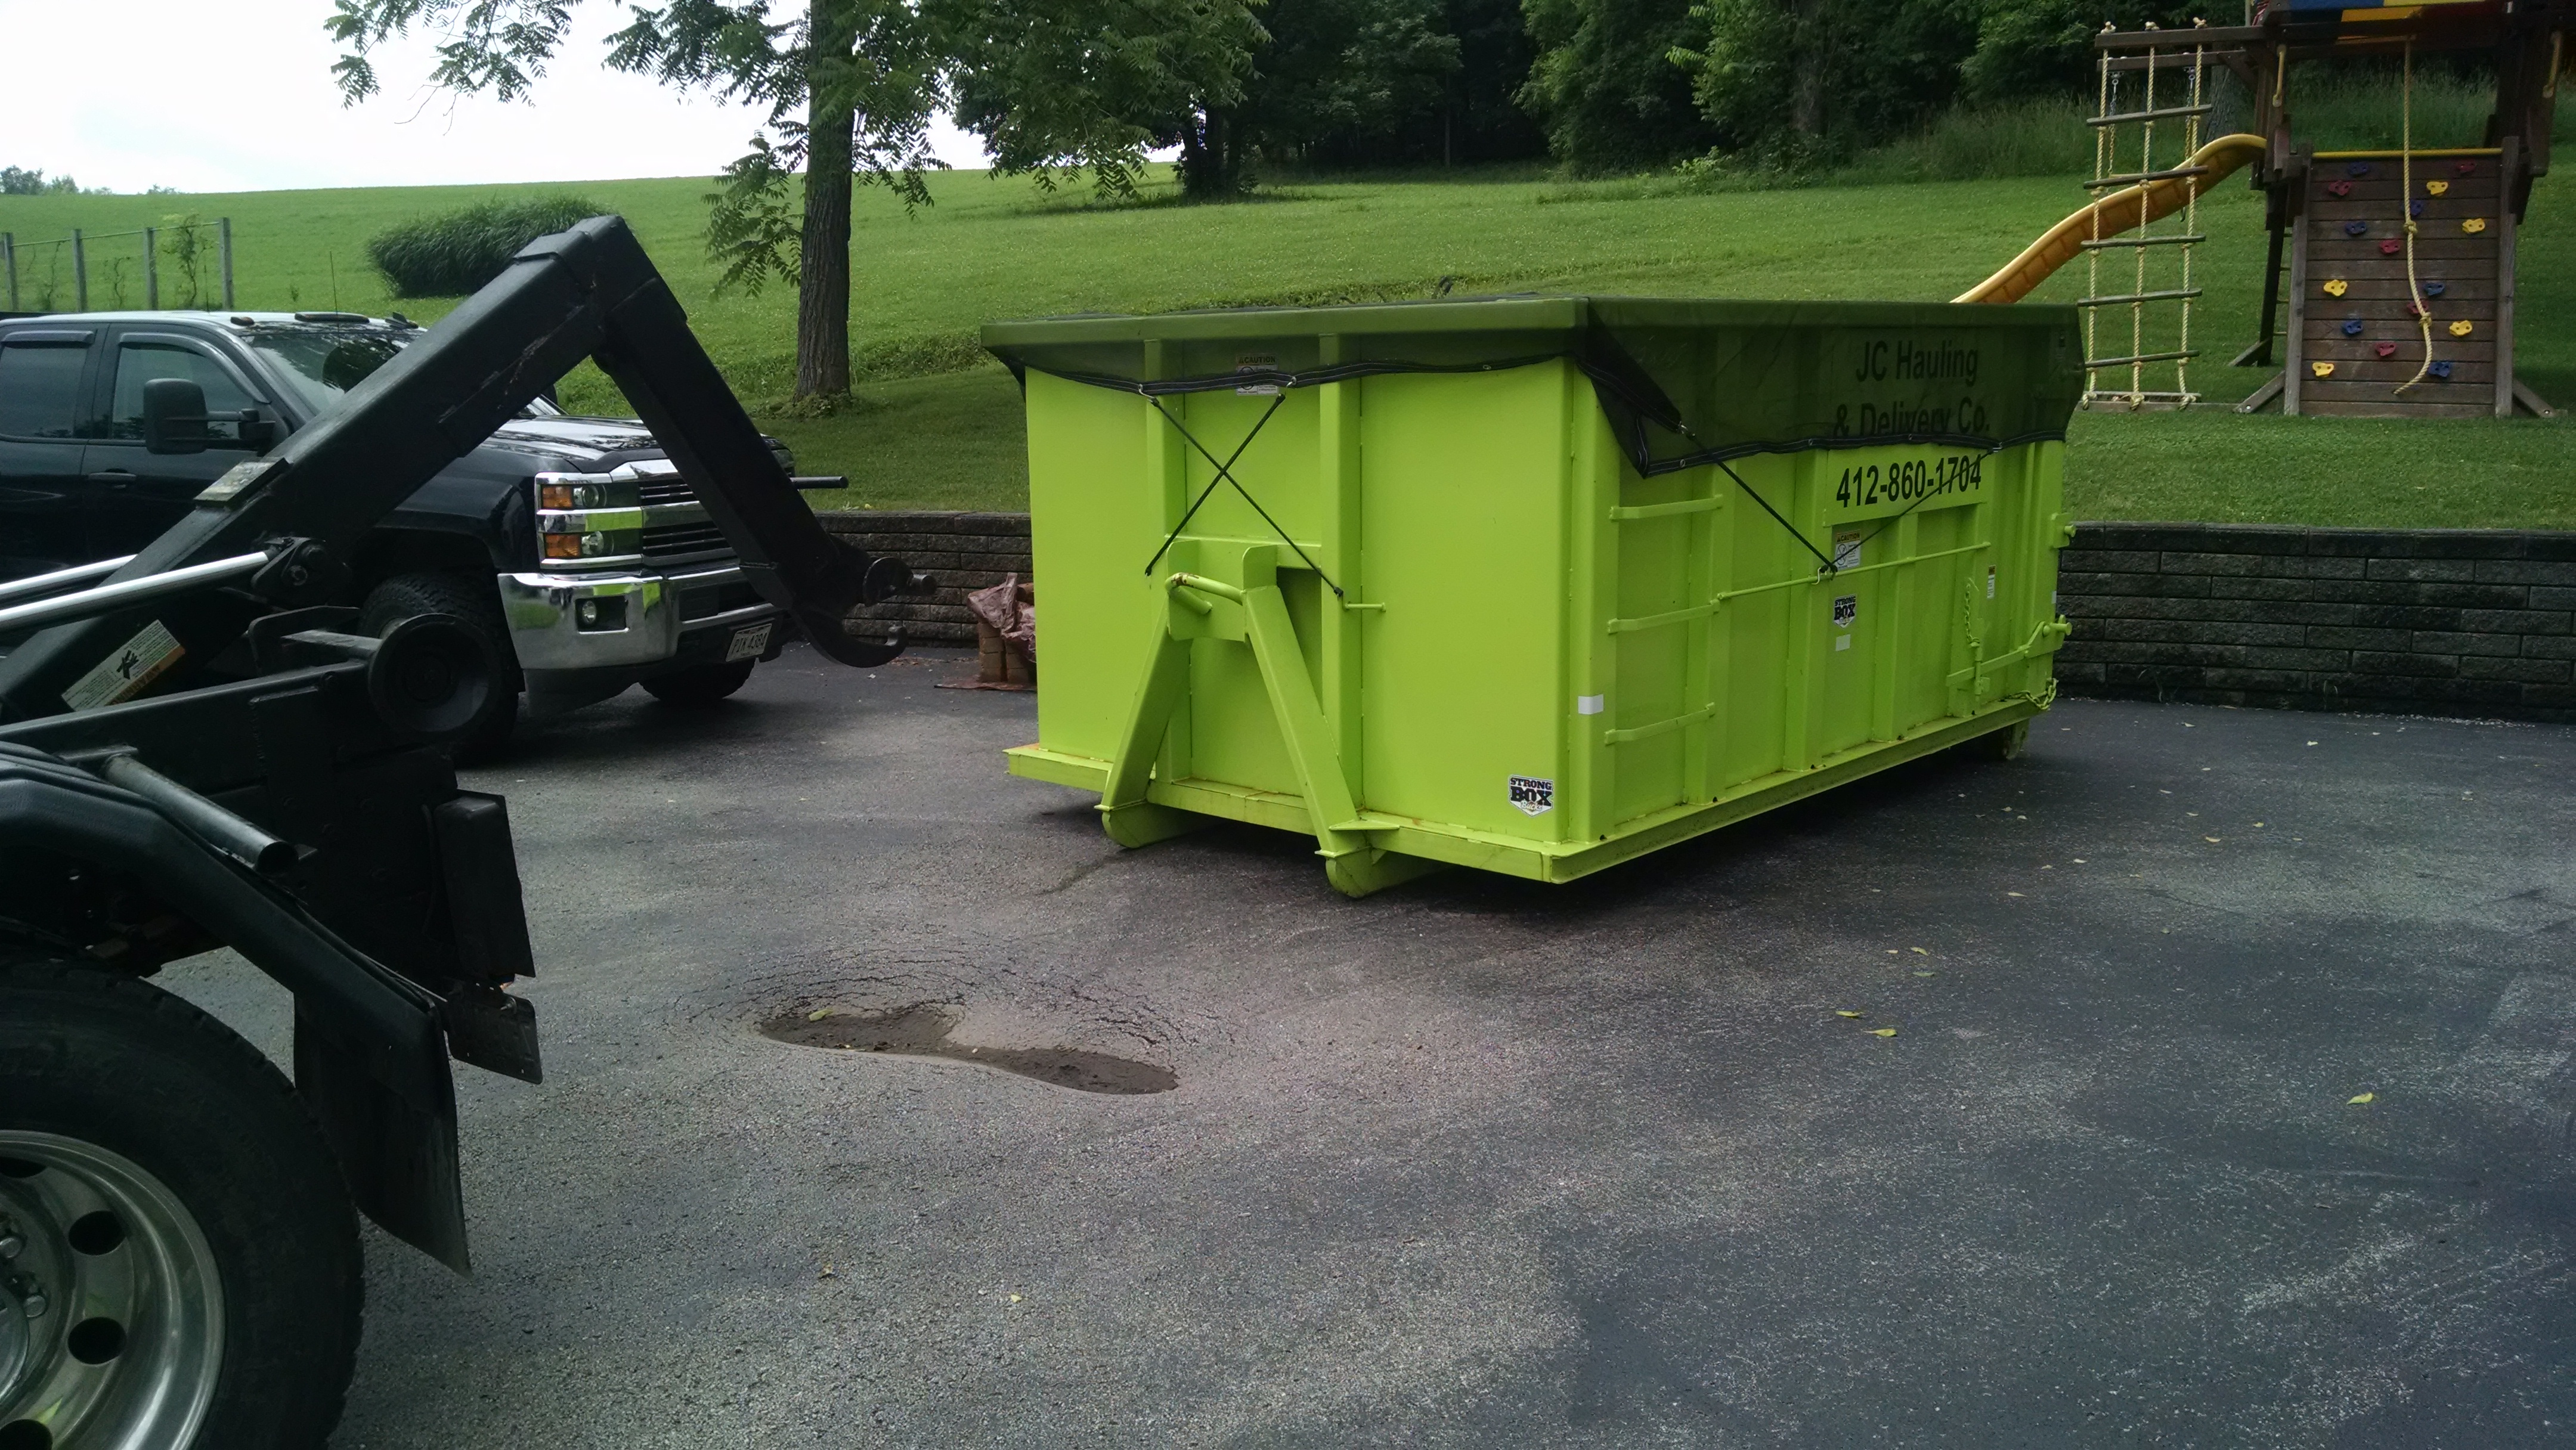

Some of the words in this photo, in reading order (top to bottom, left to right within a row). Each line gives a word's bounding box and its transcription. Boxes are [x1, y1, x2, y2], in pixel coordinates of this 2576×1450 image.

[1856, 340, 1888, 382] JC
[1896, 340, 1978, 387] Hauling
[1832, 403, 1850, 436] &
[1859, 400, 1952, 435] Delivery
[1958, 396, 1990, 433] Co.
[1836, 453, 1982, 508] 412-860-1704
[1840, 532, 1860, 541] CAUTION
[1834, 596, 1856, 606] STRONG
[1834, 603, 1856, 620] BOX
[1510, 777, 1552, 790] STRONG
[1510, 786, 1552, 807] BOX
